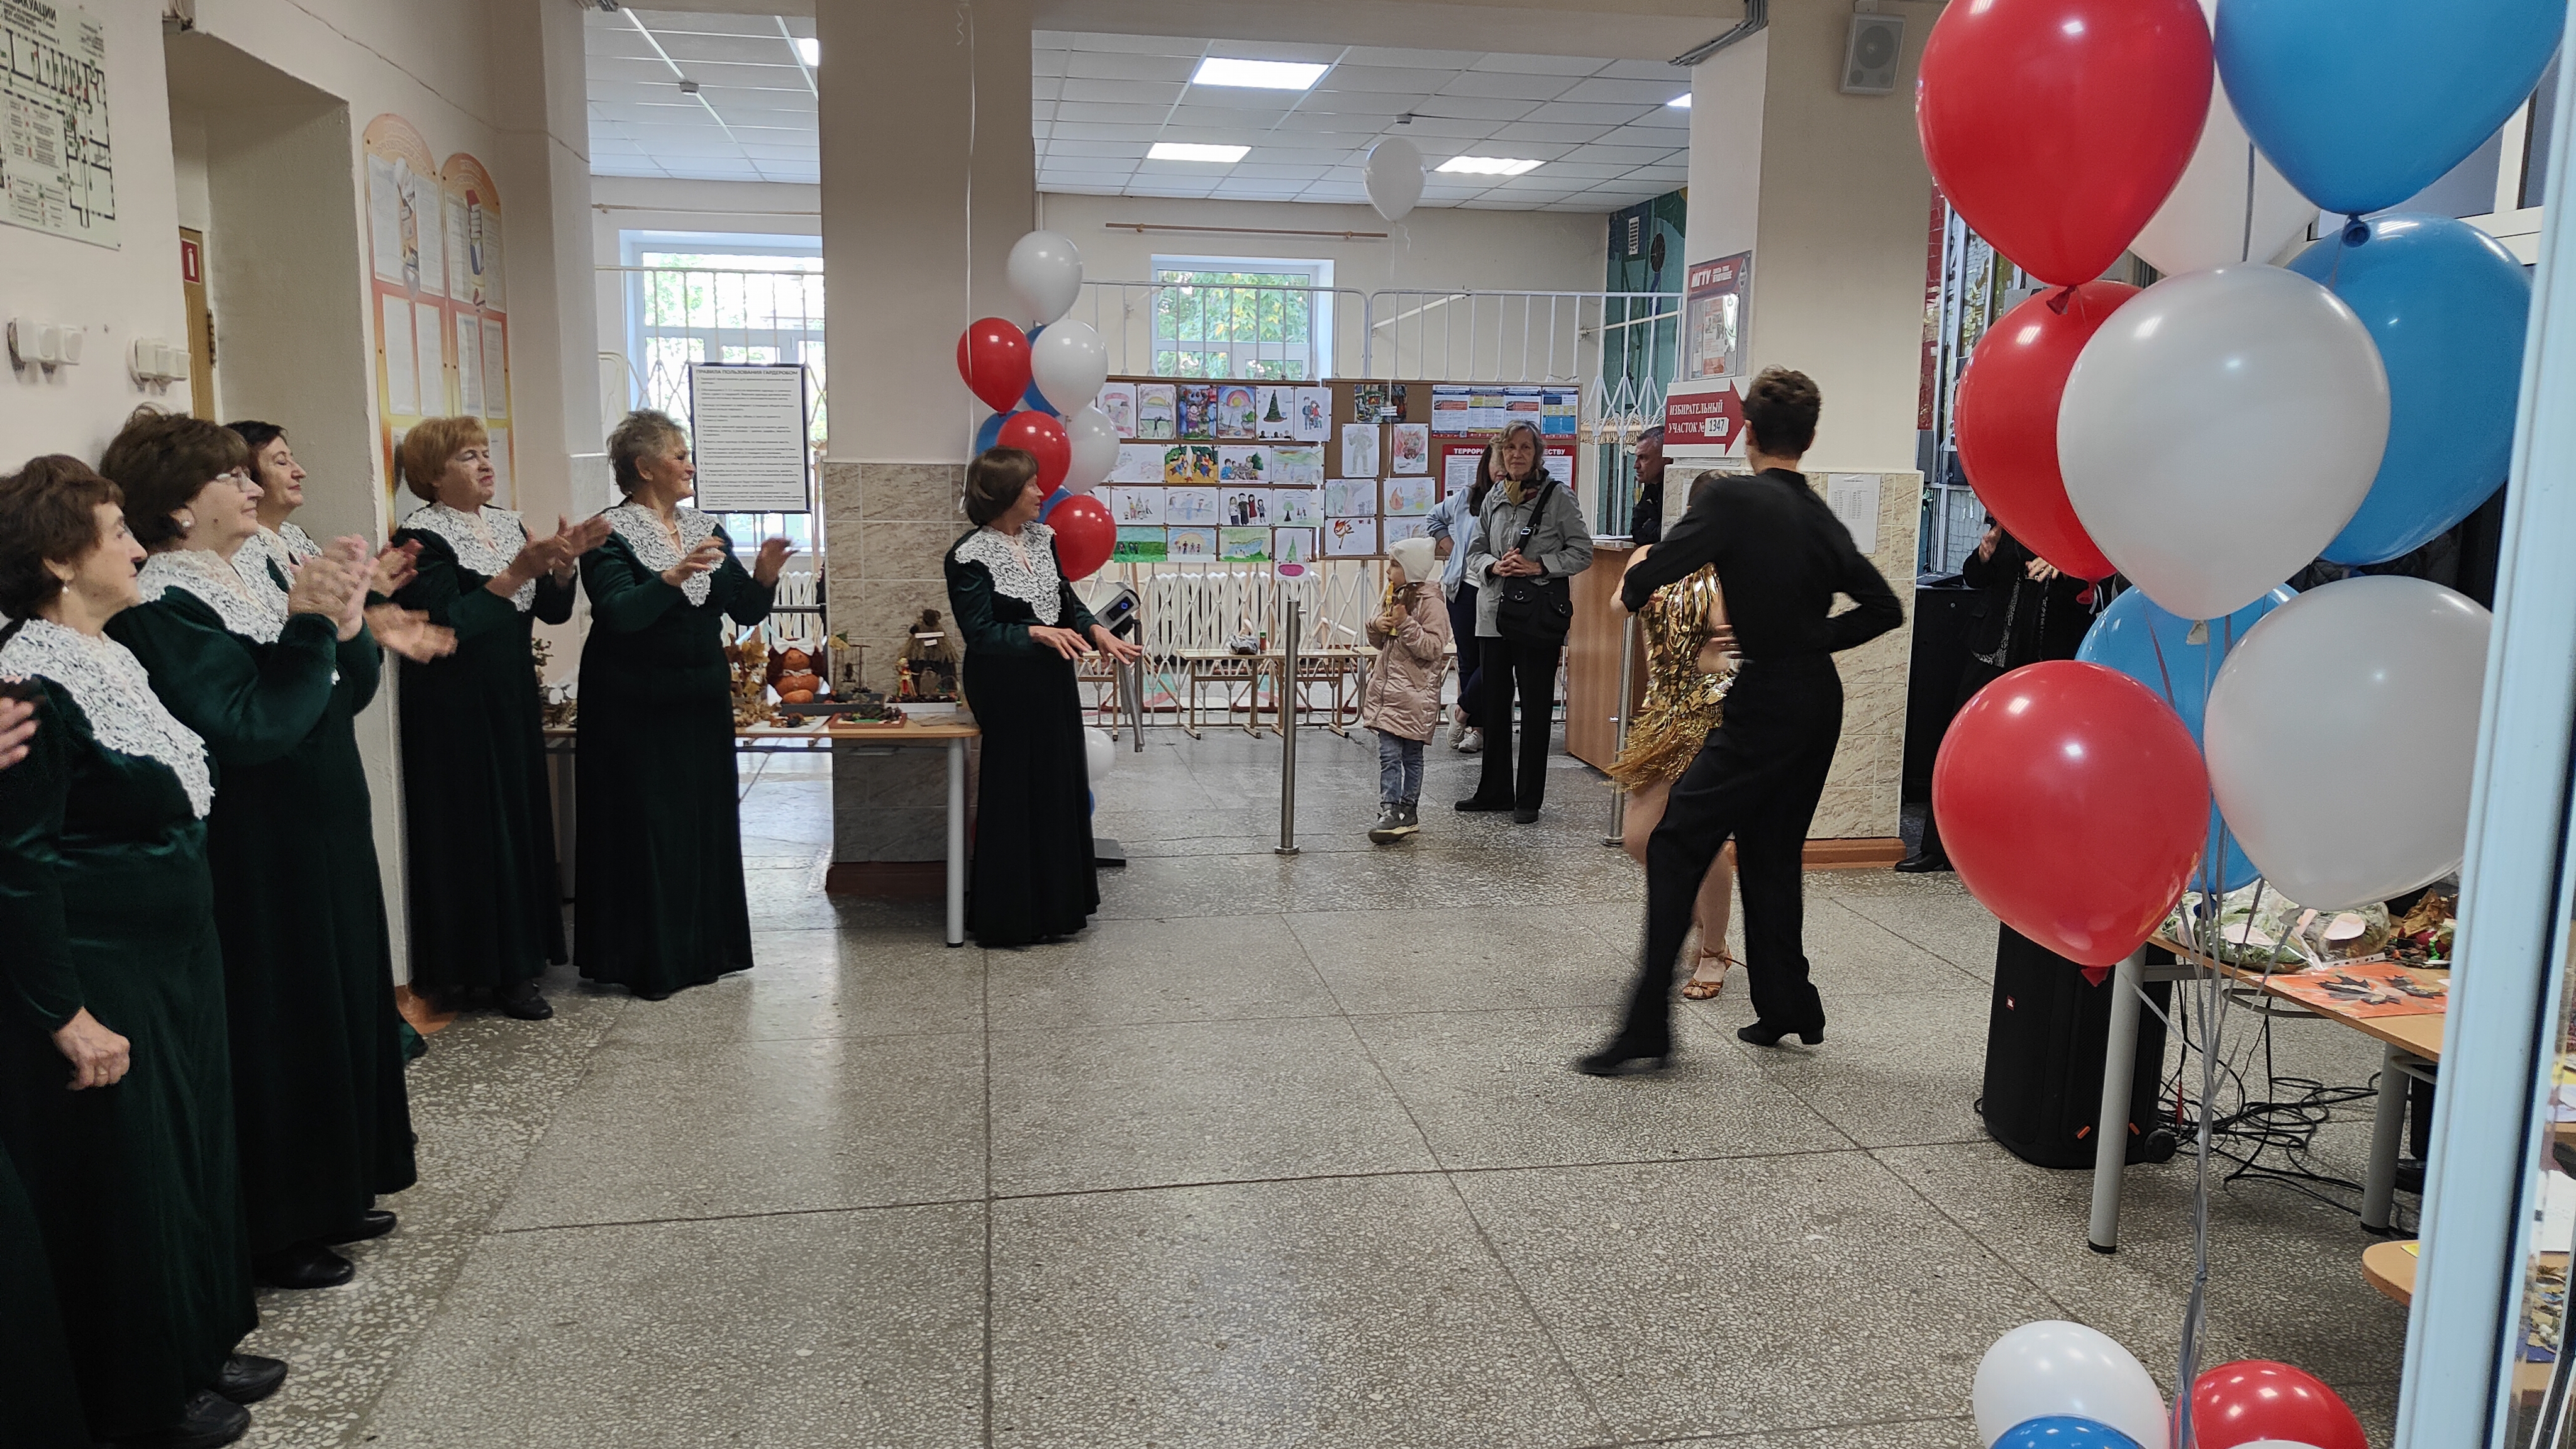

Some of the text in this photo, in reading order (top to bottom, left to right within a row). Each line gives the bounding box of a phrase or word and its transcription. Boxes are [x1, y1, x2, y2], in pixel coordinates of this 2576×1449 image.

[13, 0, 57, 23] КУАЦИИ
[1670, 399, 1723, 416] ИЗБИРАТЕЛЬНЫЙ
[1668, 422, 1698, 434] УЧАСТОК
[1709, 419, 1725, 432] 1347
